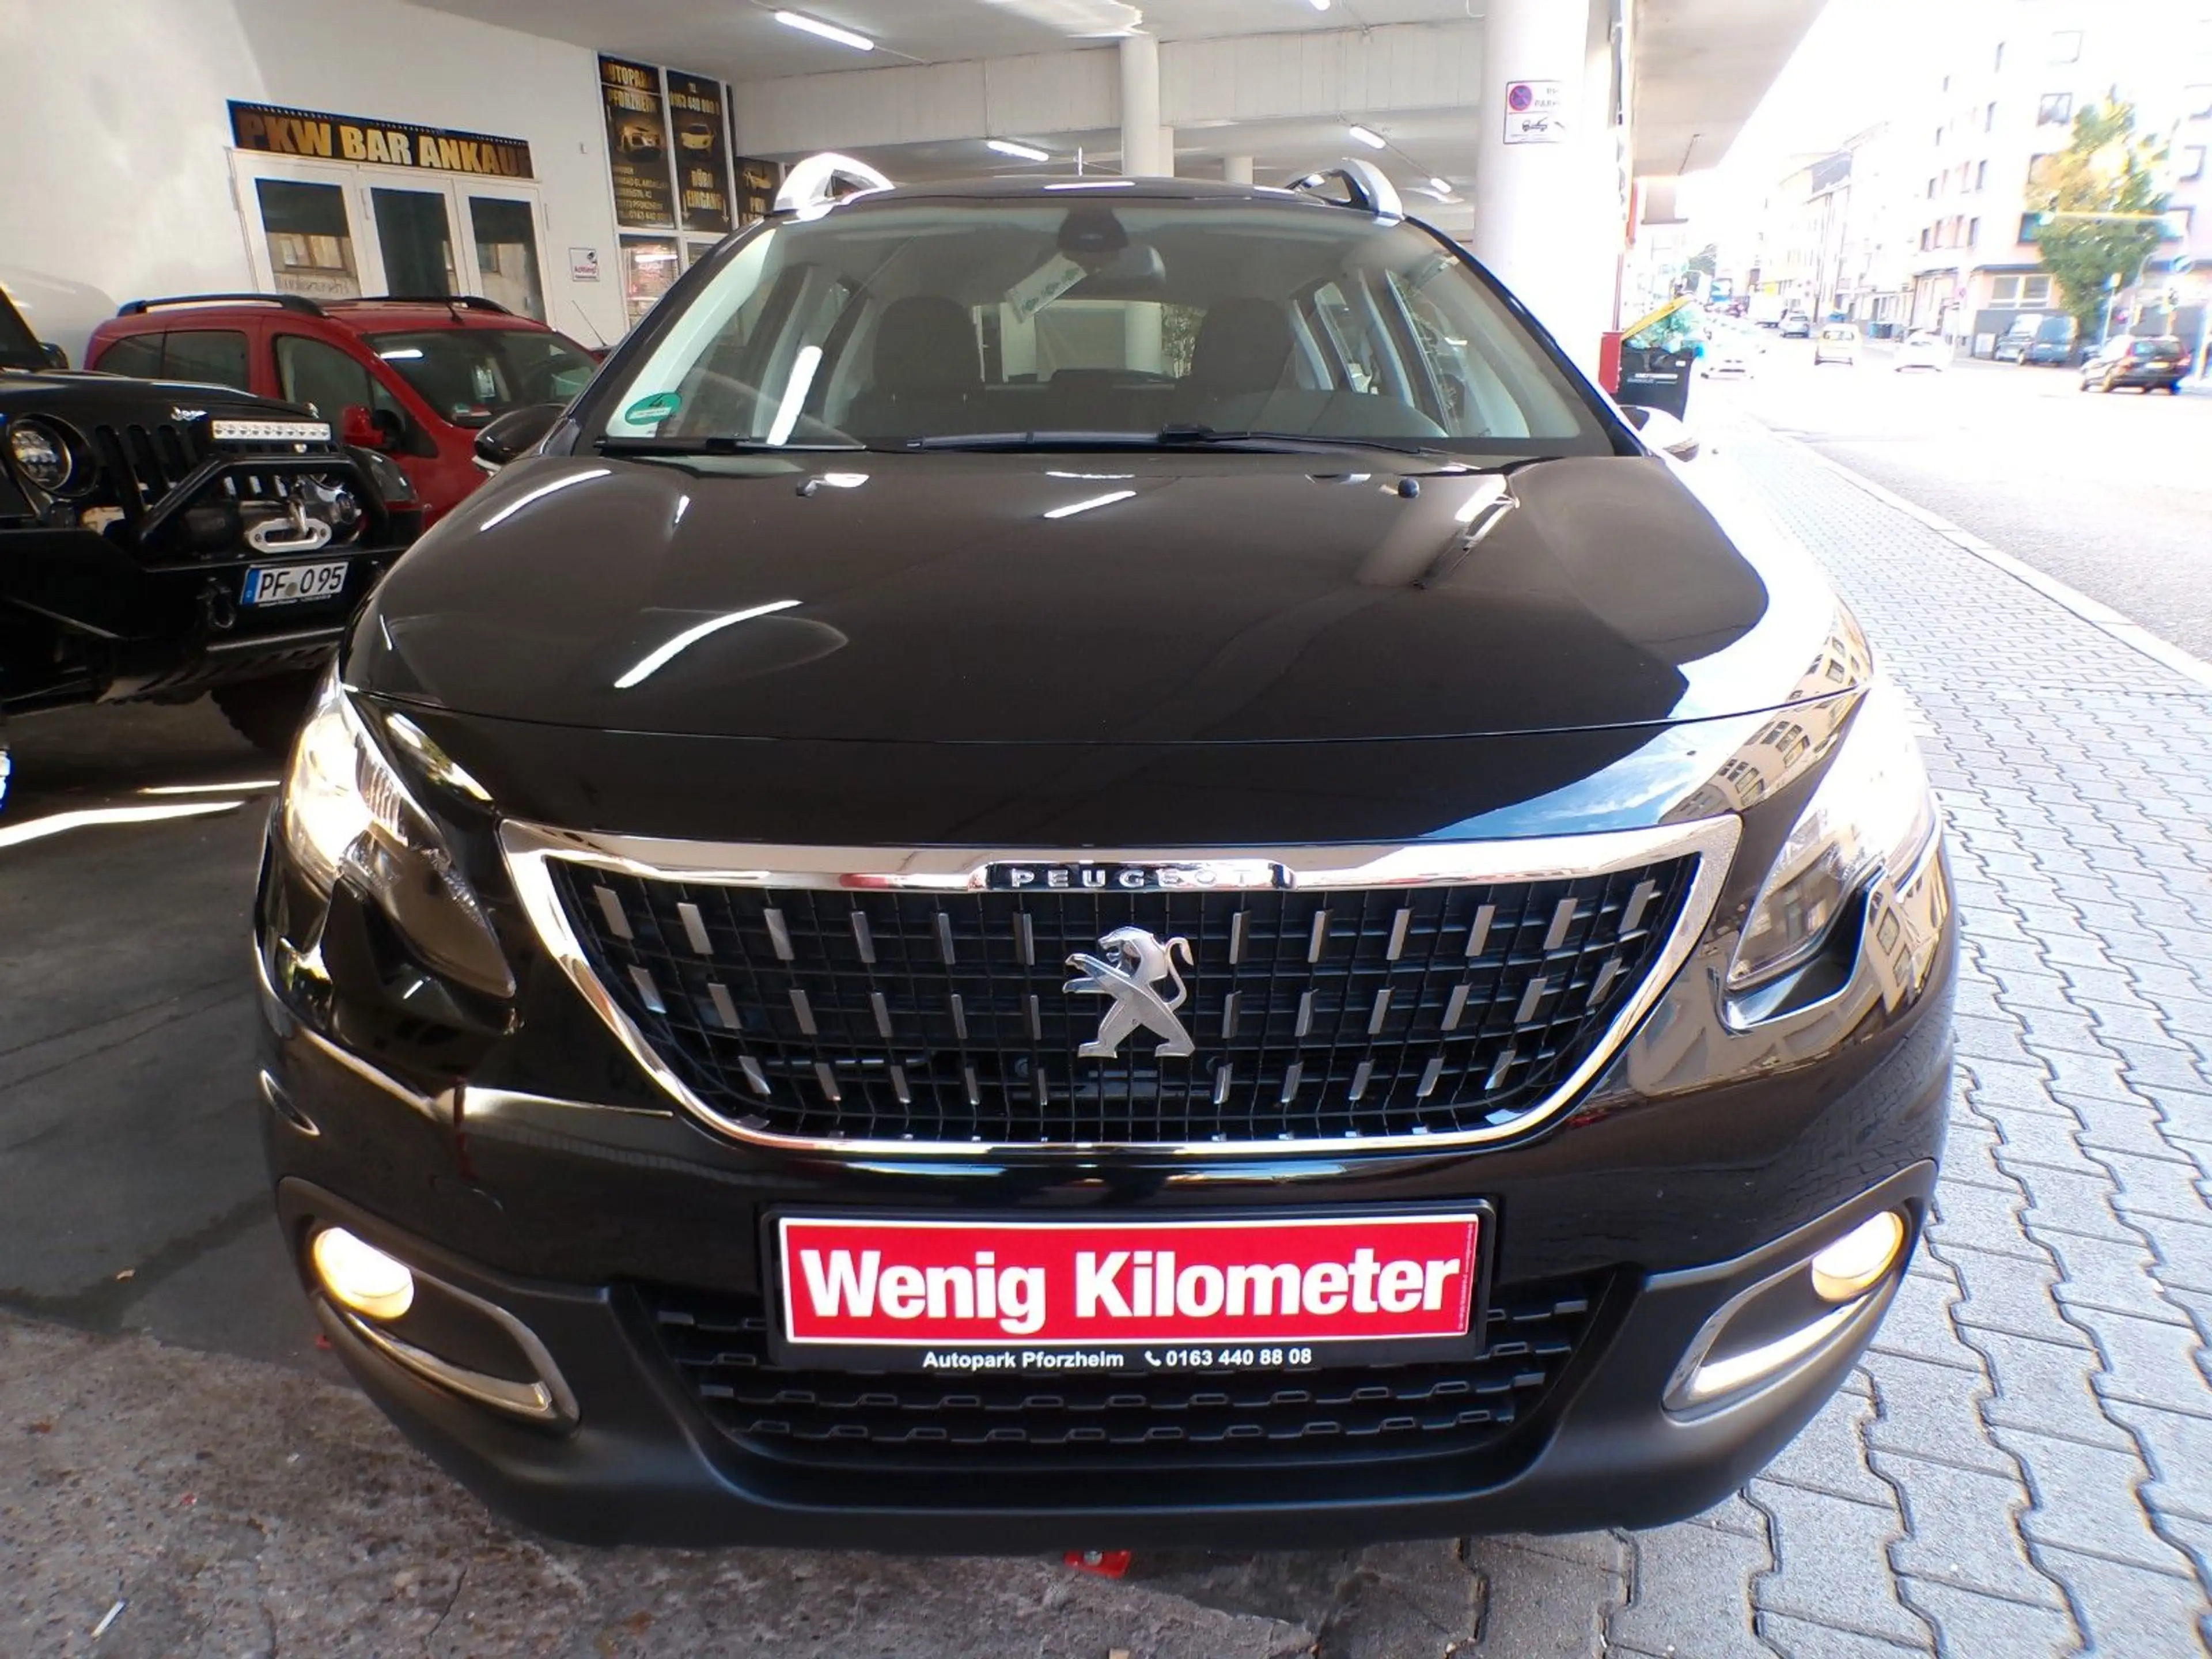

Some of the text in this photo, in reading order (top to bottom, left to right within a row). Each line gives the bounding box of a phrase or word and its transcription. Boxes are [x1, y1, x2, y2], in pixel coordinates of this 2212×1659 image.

[238, 112, 332, 157] PKW
[339, 126, 412, 165] BAR
[259, 571, 290, 598] PF
[1012, 868, 1252, 888] PEUGEOT
[800, 1249, 1046, 1334] Wenig
[1075, 1248, 1460, 1318] Kilometer
[923, 1347, 1312, 1371] Autopark Pforzheim 0163 440 88 08
